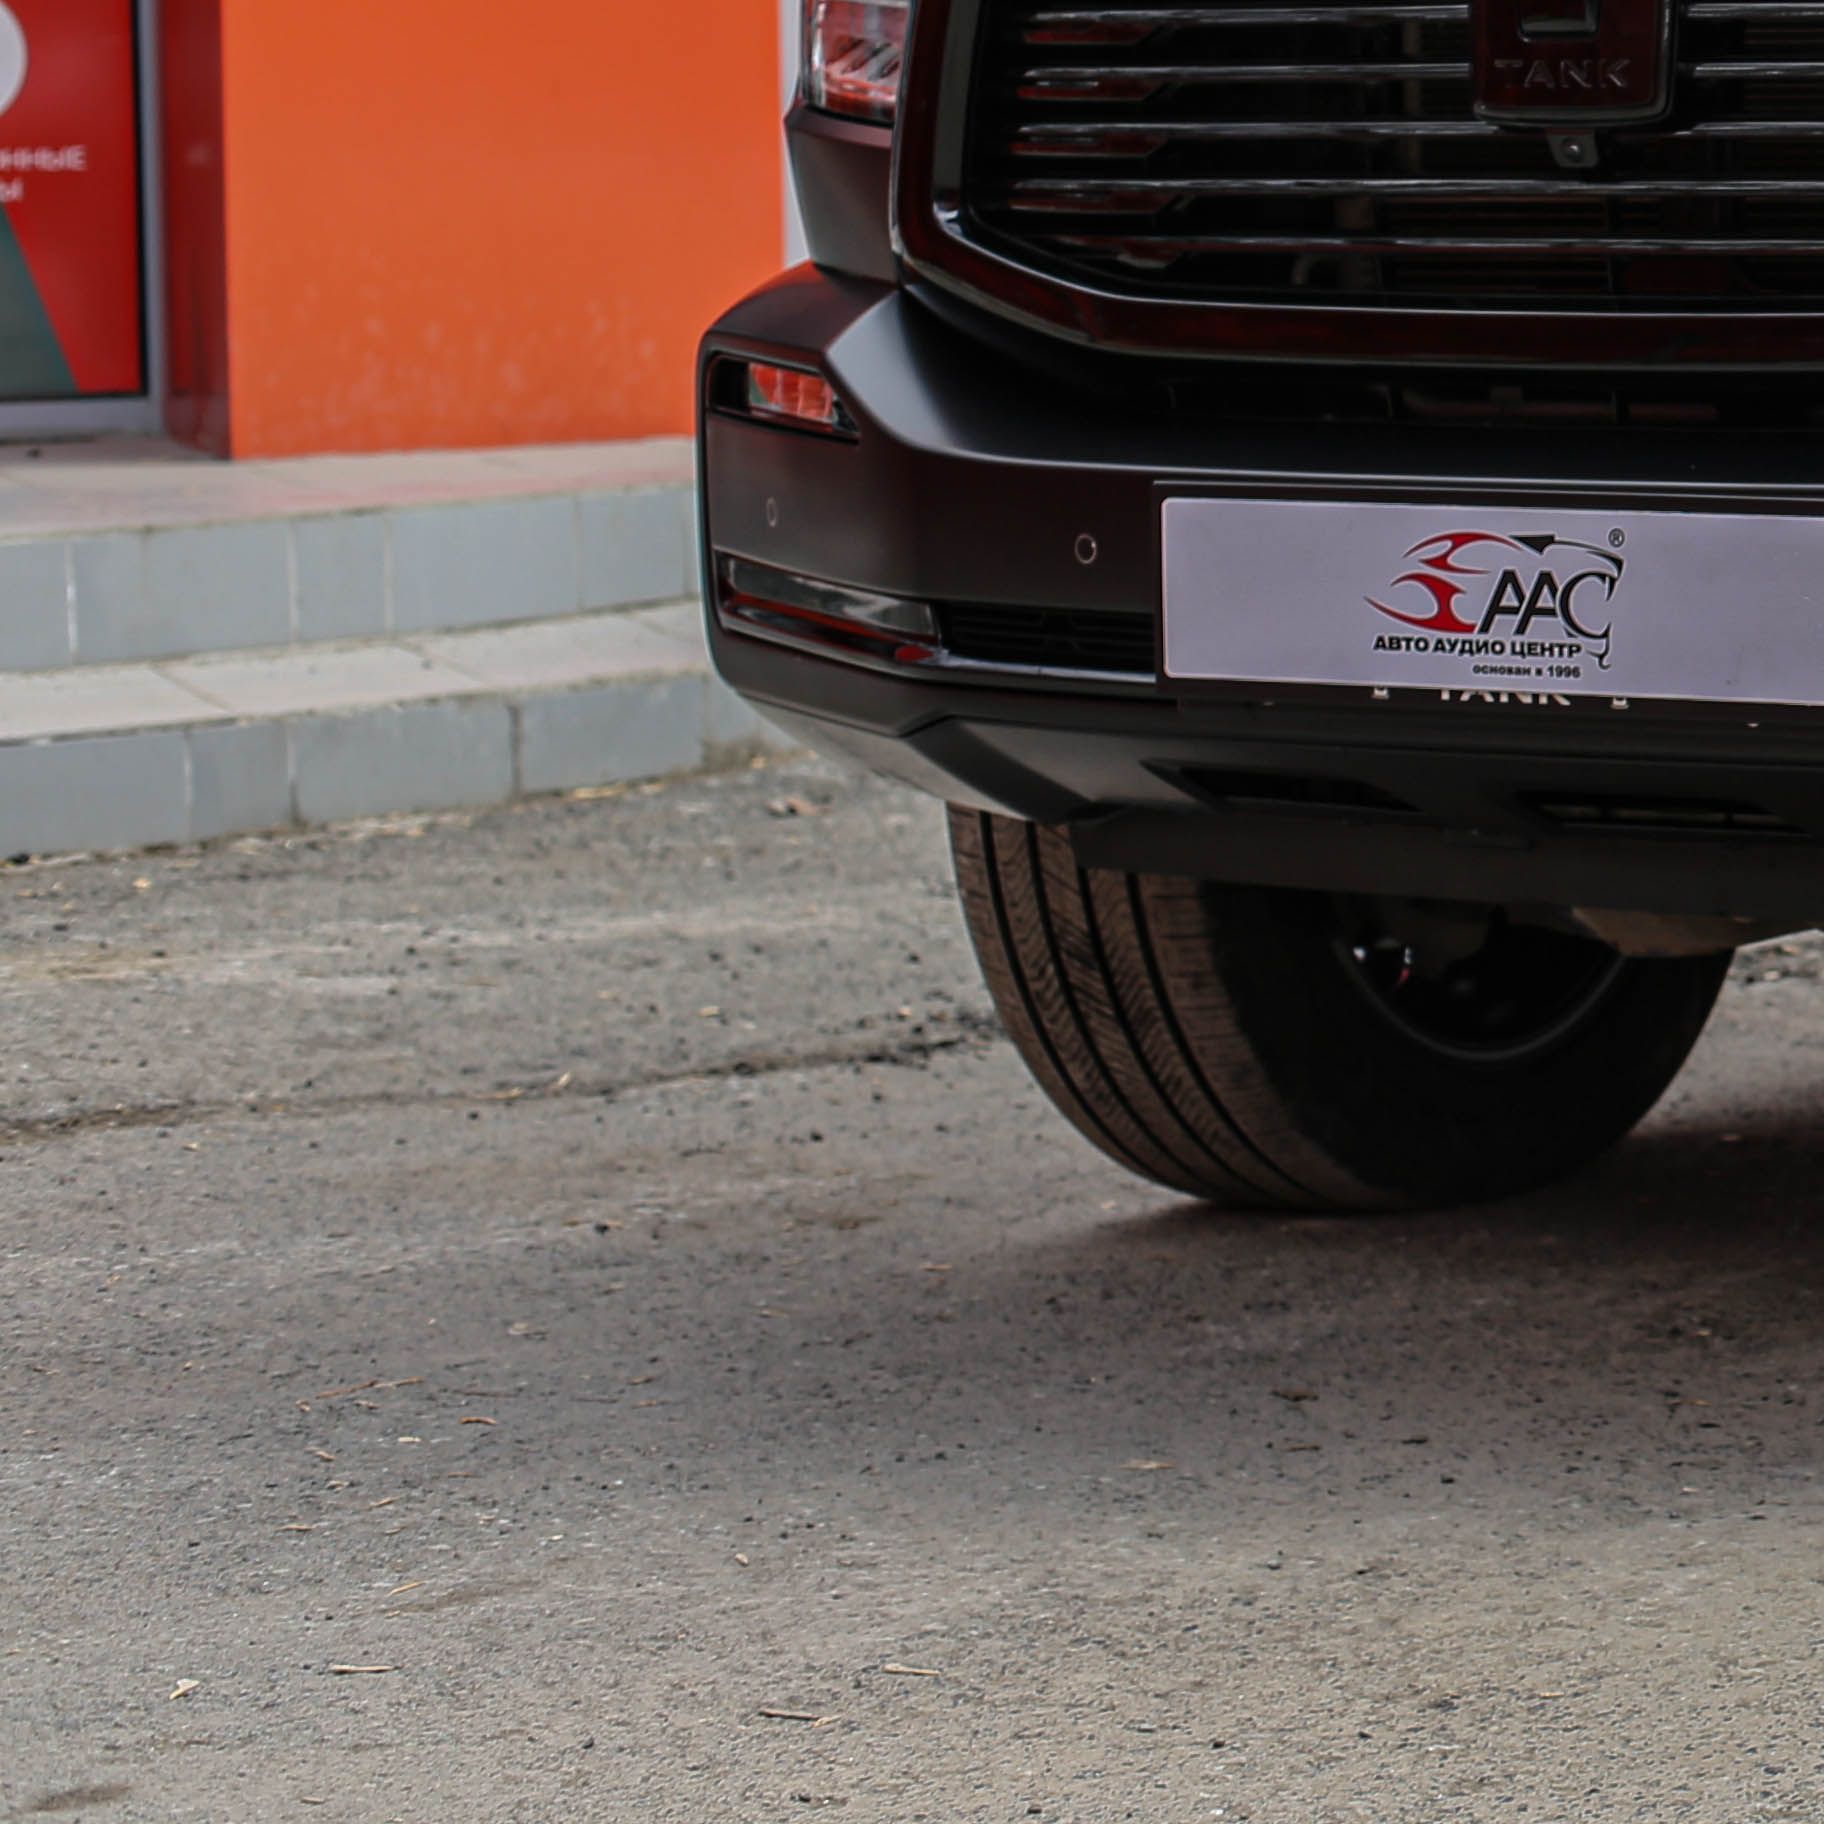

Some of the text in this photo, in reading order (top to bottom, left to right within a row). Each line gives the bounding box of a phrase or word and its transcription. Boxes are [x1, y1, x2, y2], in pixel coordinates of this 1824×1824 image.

[1494, 58, 1631, 89] TANK
[1373, 635, 1583, 659] АВТО АУДИО ЦЕНТР
[1472, 664, 1532, 677] основан
[1547, 665, 1582, 678] 1996
